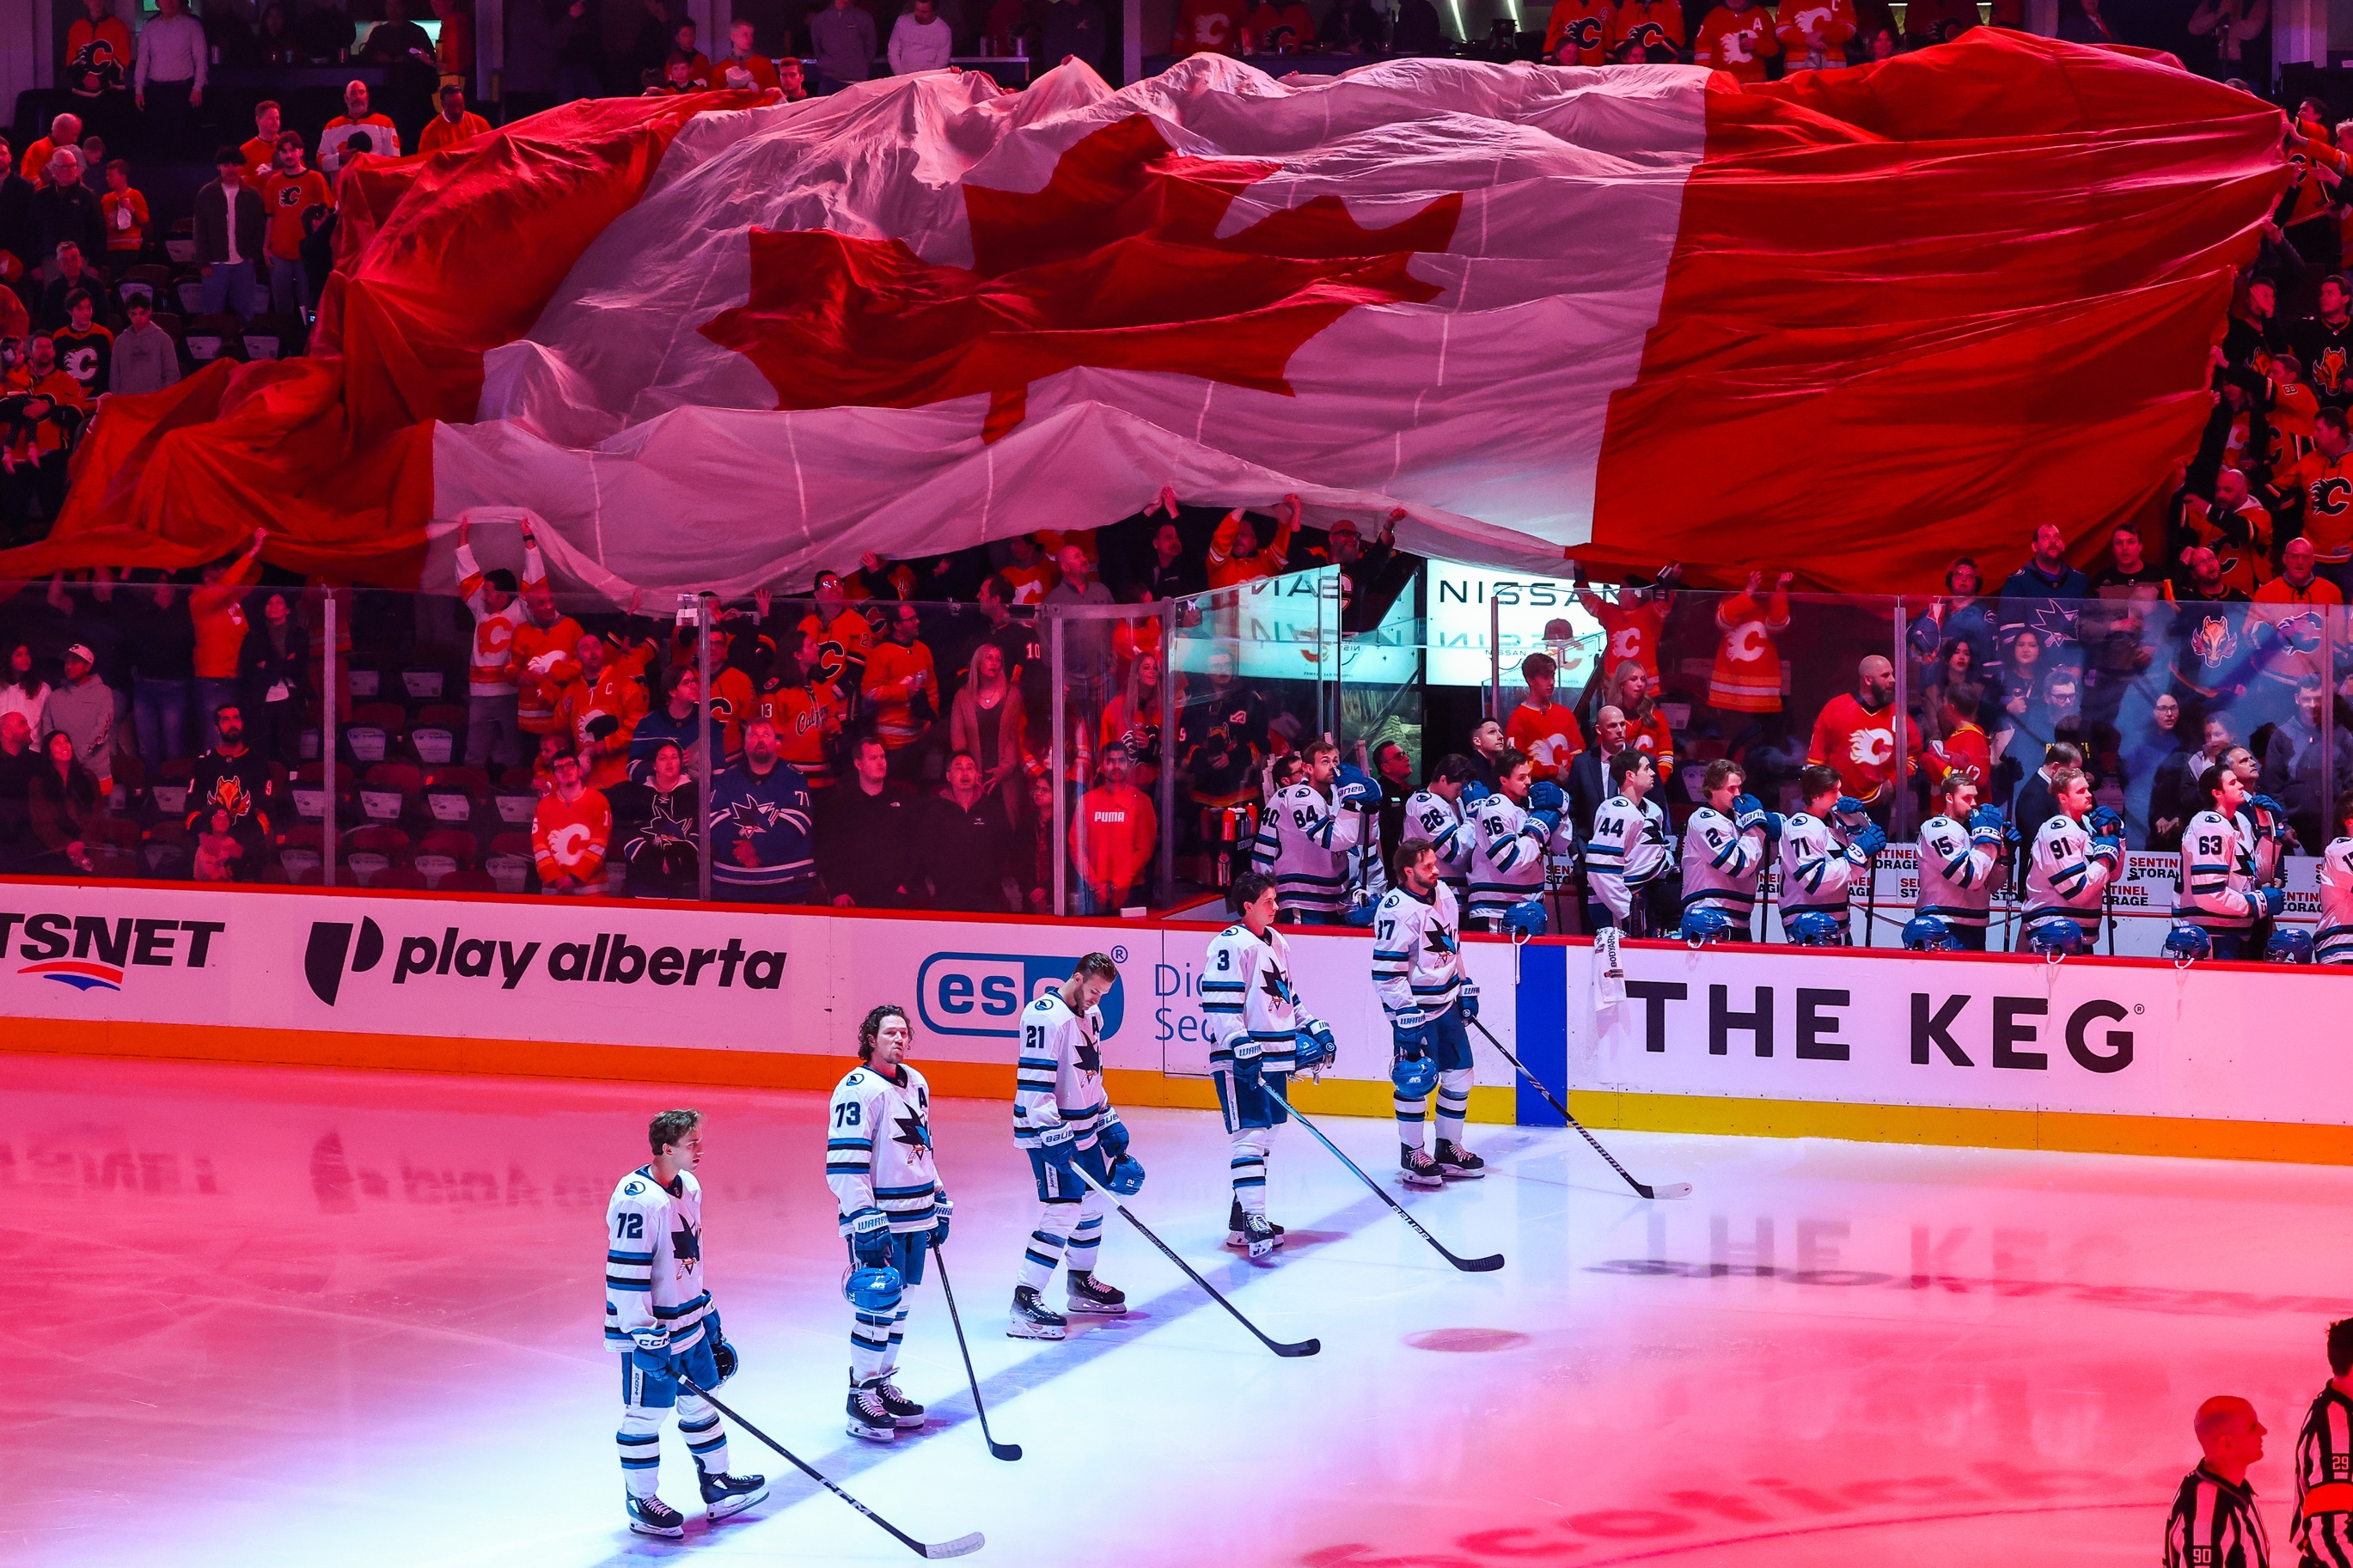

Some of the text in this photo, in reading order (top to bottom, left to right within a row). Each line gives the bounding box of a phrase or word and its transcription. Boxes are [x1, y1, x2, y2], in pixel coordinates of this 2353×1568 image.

[1752, 18, 1763, 31] A
[761, 703, 773, 718] 13
[794, 790, 810, 807] 71
[1094, 811, 1125, 822] PUMA
[1293, 805, 1319, 828] 84
[1598, 817, 1624, 838] 44
[1705, 827, 1723, 848] 2
[1790, 837, 1811, 858] 71
[1931, 835, 1954, 857] 15
[2050, 837, 2072, 860] 91
[2198, 835, 2222, 856] 63
[2129, 857, 2179, 868] SENTIN
[2129, 868, 2179, 878] STORA
[392, 927, 787, 990] play alberta
[1217, 949, 1230, 971] 3
[1025, 1025, 1045, 1049] 21
[1624, 980, 2134, 1074] THE KEG
[918, 1087, 928, 1108] A
[835, 1101, 861, 1128] 73
[617, 1212, 644, 1239] 72
[2332, 1455, 2350, 1470] 29
[2193, 1548, 2212, 1564] 90
